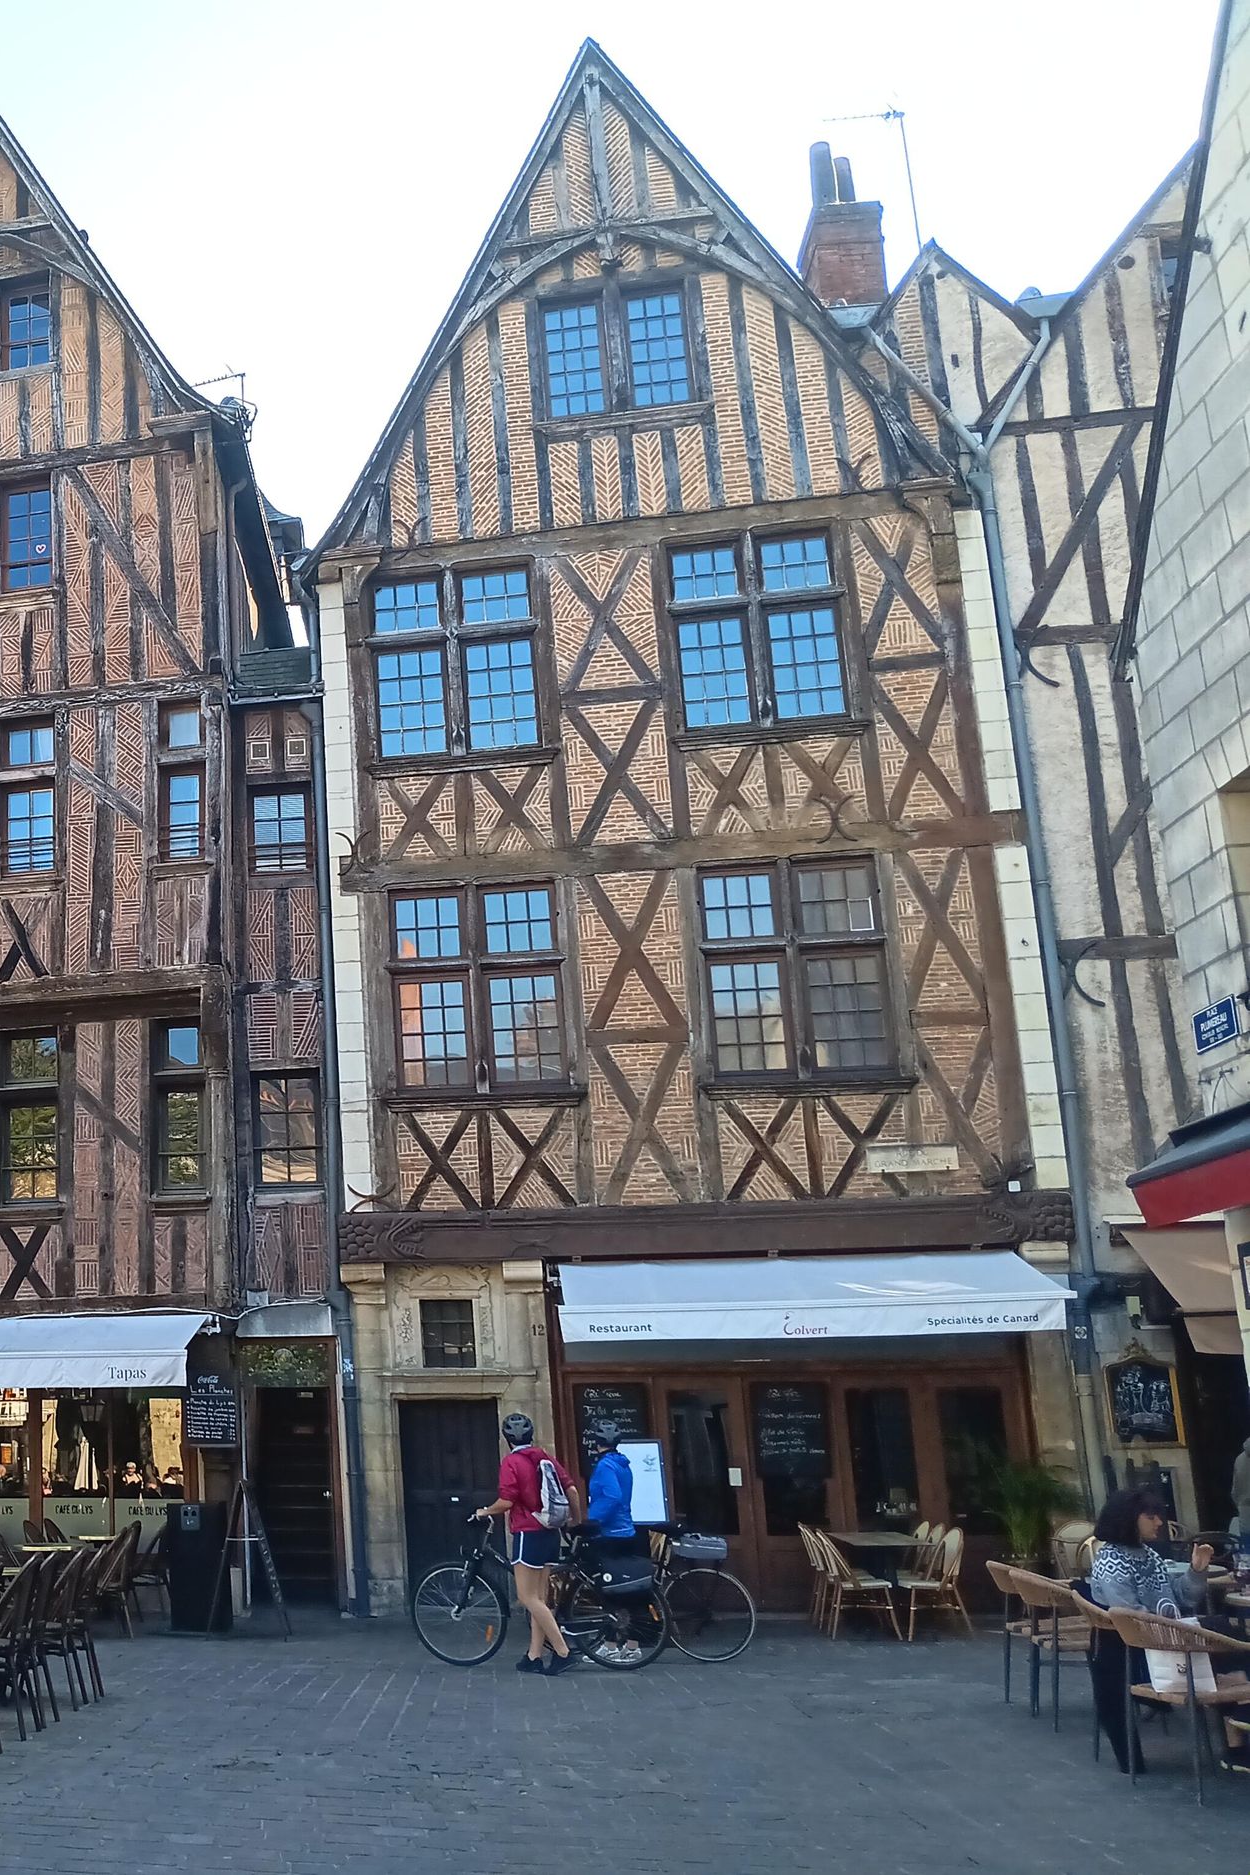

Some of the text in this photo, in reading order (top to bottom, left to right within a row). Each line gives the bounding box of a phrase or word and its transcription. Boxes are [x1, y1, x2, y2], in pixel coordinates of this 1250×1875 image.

[986, 1314, 1000, 1324] de
[1002, 1313, 1039, 1323] Canard
[531, 1323, 546, 1337] 12
[589, 1323, 652, 1333] Restaurant
[107, 1366, 147, 1380] Tapas
